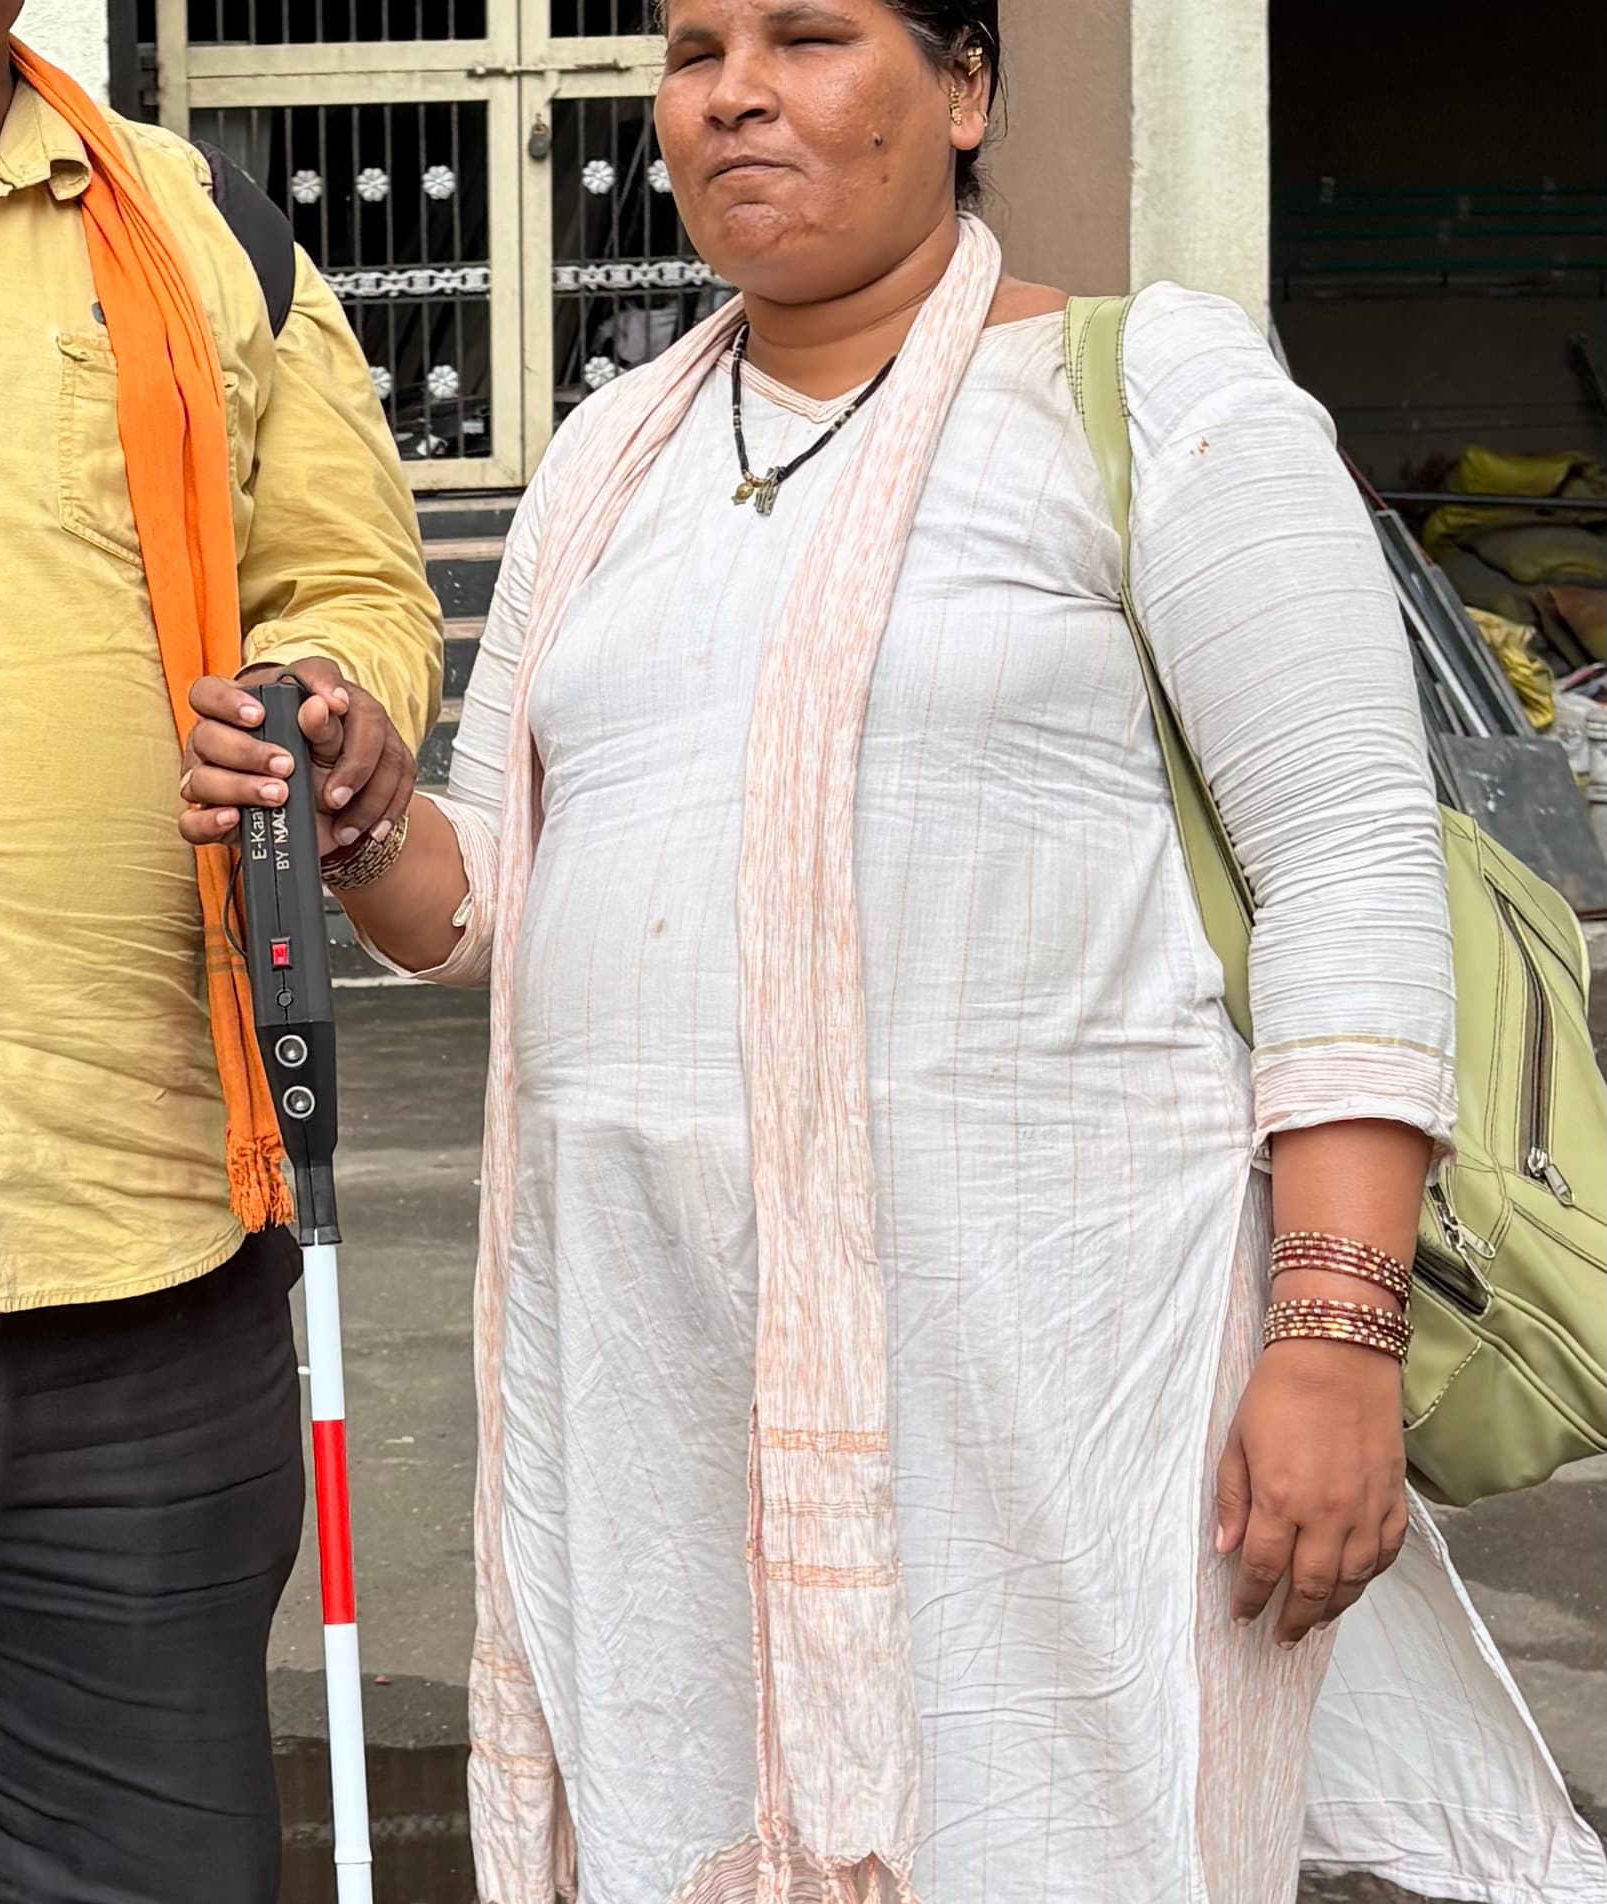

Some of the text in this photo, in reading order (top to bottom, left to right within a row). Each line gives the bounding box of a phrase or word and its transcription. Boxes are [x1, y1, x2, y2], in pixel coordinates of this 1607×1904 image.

[251, 807, 267, 860] E-Kaa
[272, 807, 290, 871] BY MAC
